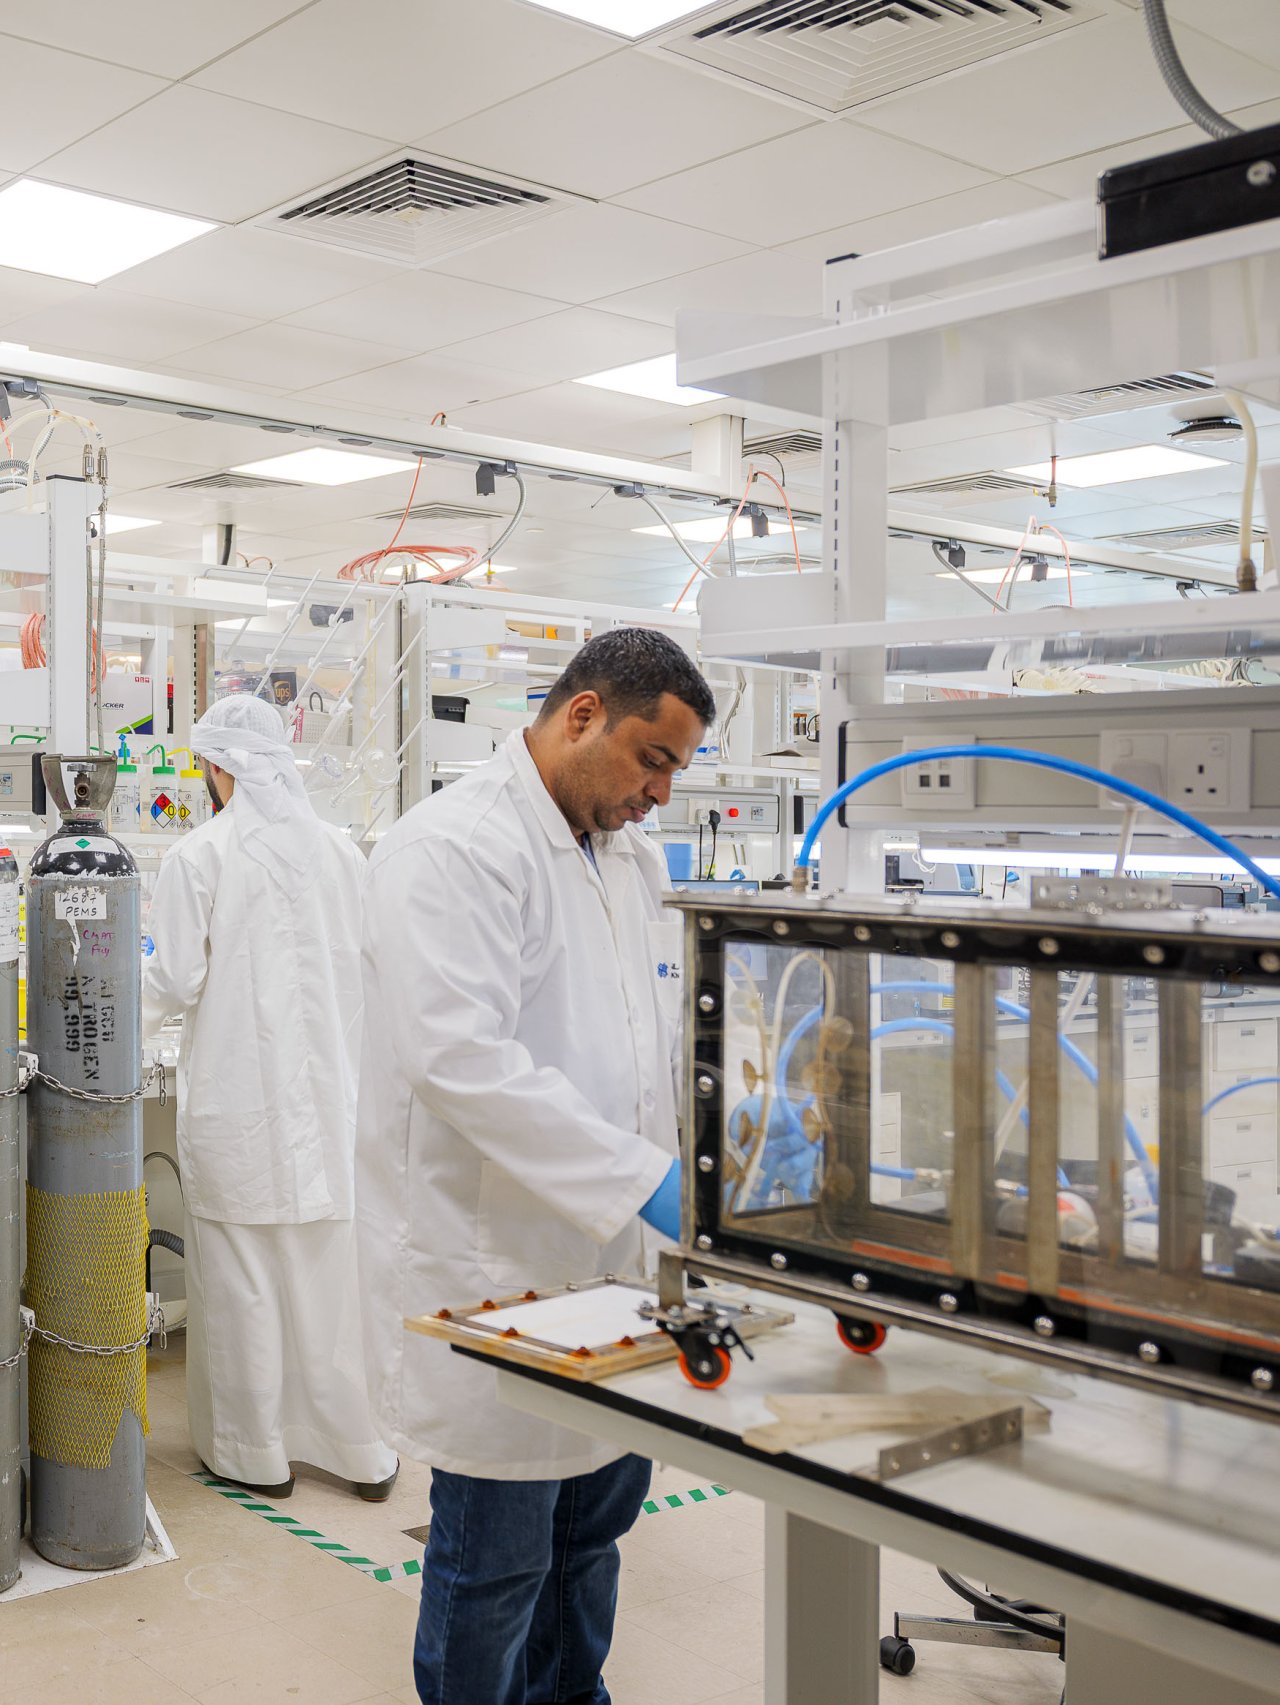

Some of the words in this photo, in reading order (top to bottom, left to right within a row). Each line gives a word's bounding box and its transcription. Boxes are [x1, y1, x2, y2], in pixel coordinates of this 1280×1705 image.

[276, 687, 290, 701] ups
[160, 796, 167, 807] 3
[168, 805, 175, 816] 0
[180, 807, 187, 818] 0
[65, 906, 98, 918] PEMS
[82, 975, 100, 1080] NITROGEN
